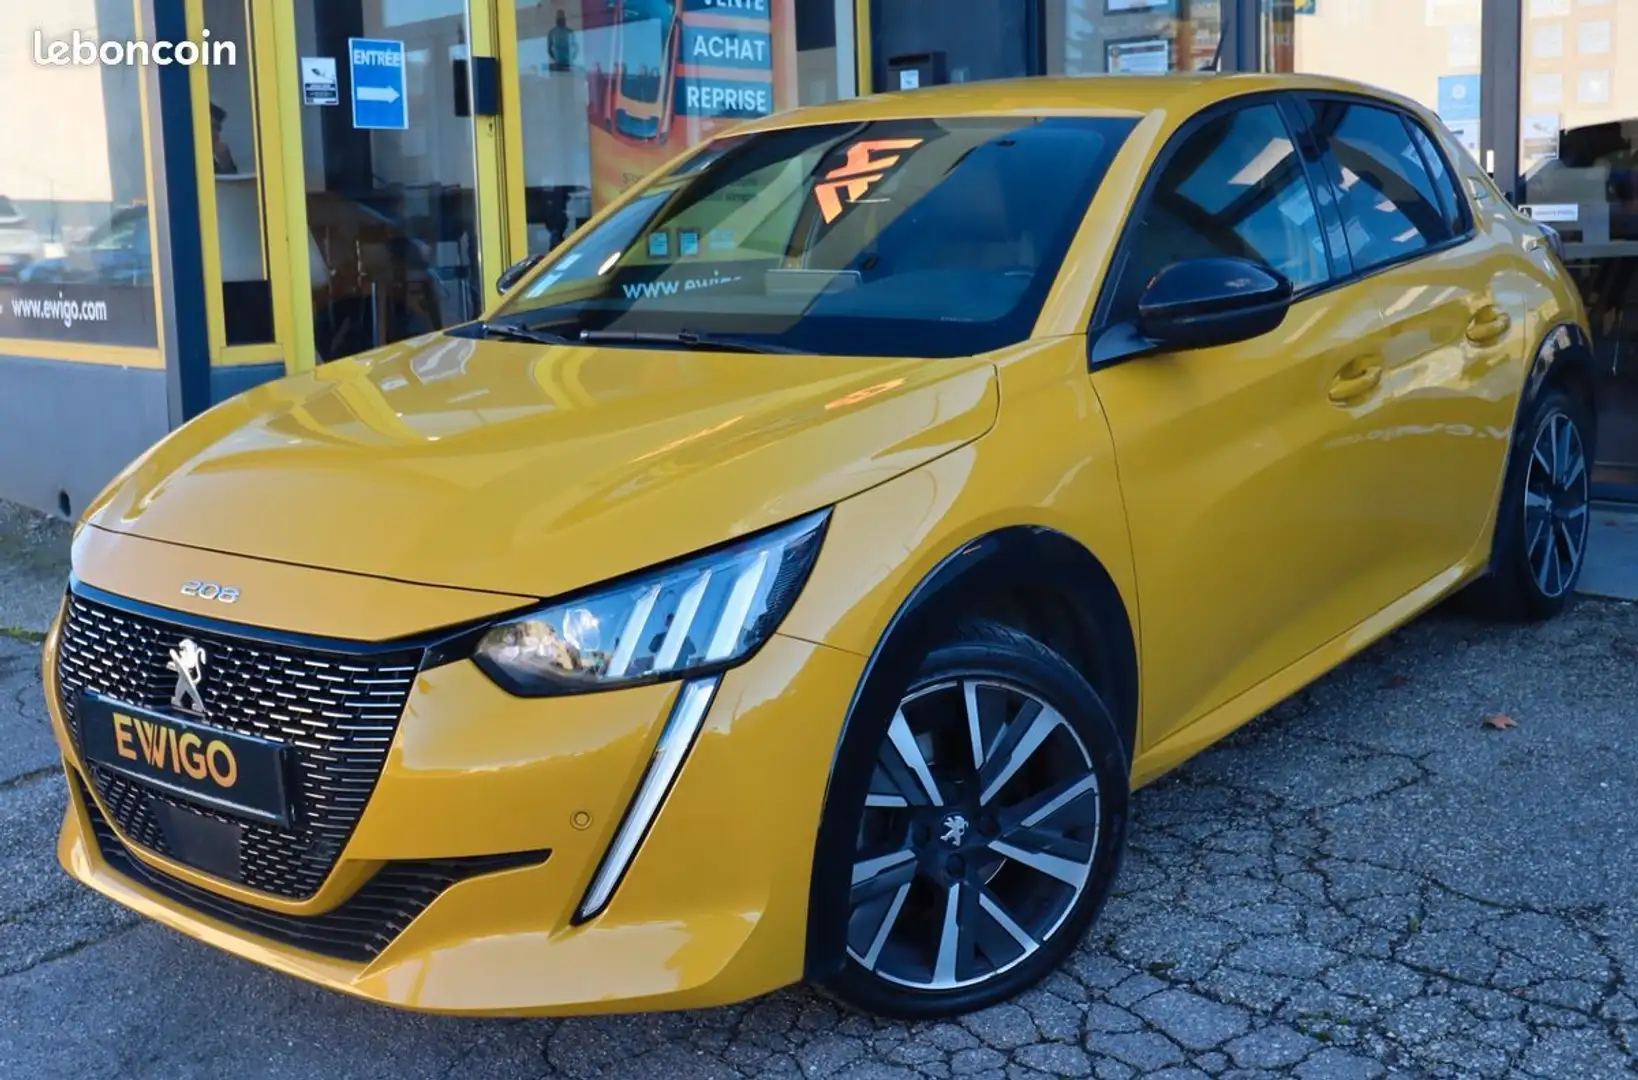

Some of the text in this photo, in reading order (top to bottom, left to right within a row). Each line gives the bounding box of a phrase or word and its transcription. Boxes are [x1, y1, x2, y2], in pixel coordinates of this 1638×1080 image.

[353, 48, 401, 66] ENTRÉE
[693, 35, 765, 61] ACHAT
[687, 85, 767, 112] REPRISE
[11, 291, 107, 327] www.ewigo.com
[181, 581, 240, 604] 208
[113, 713, 237, 787] EWIGO
